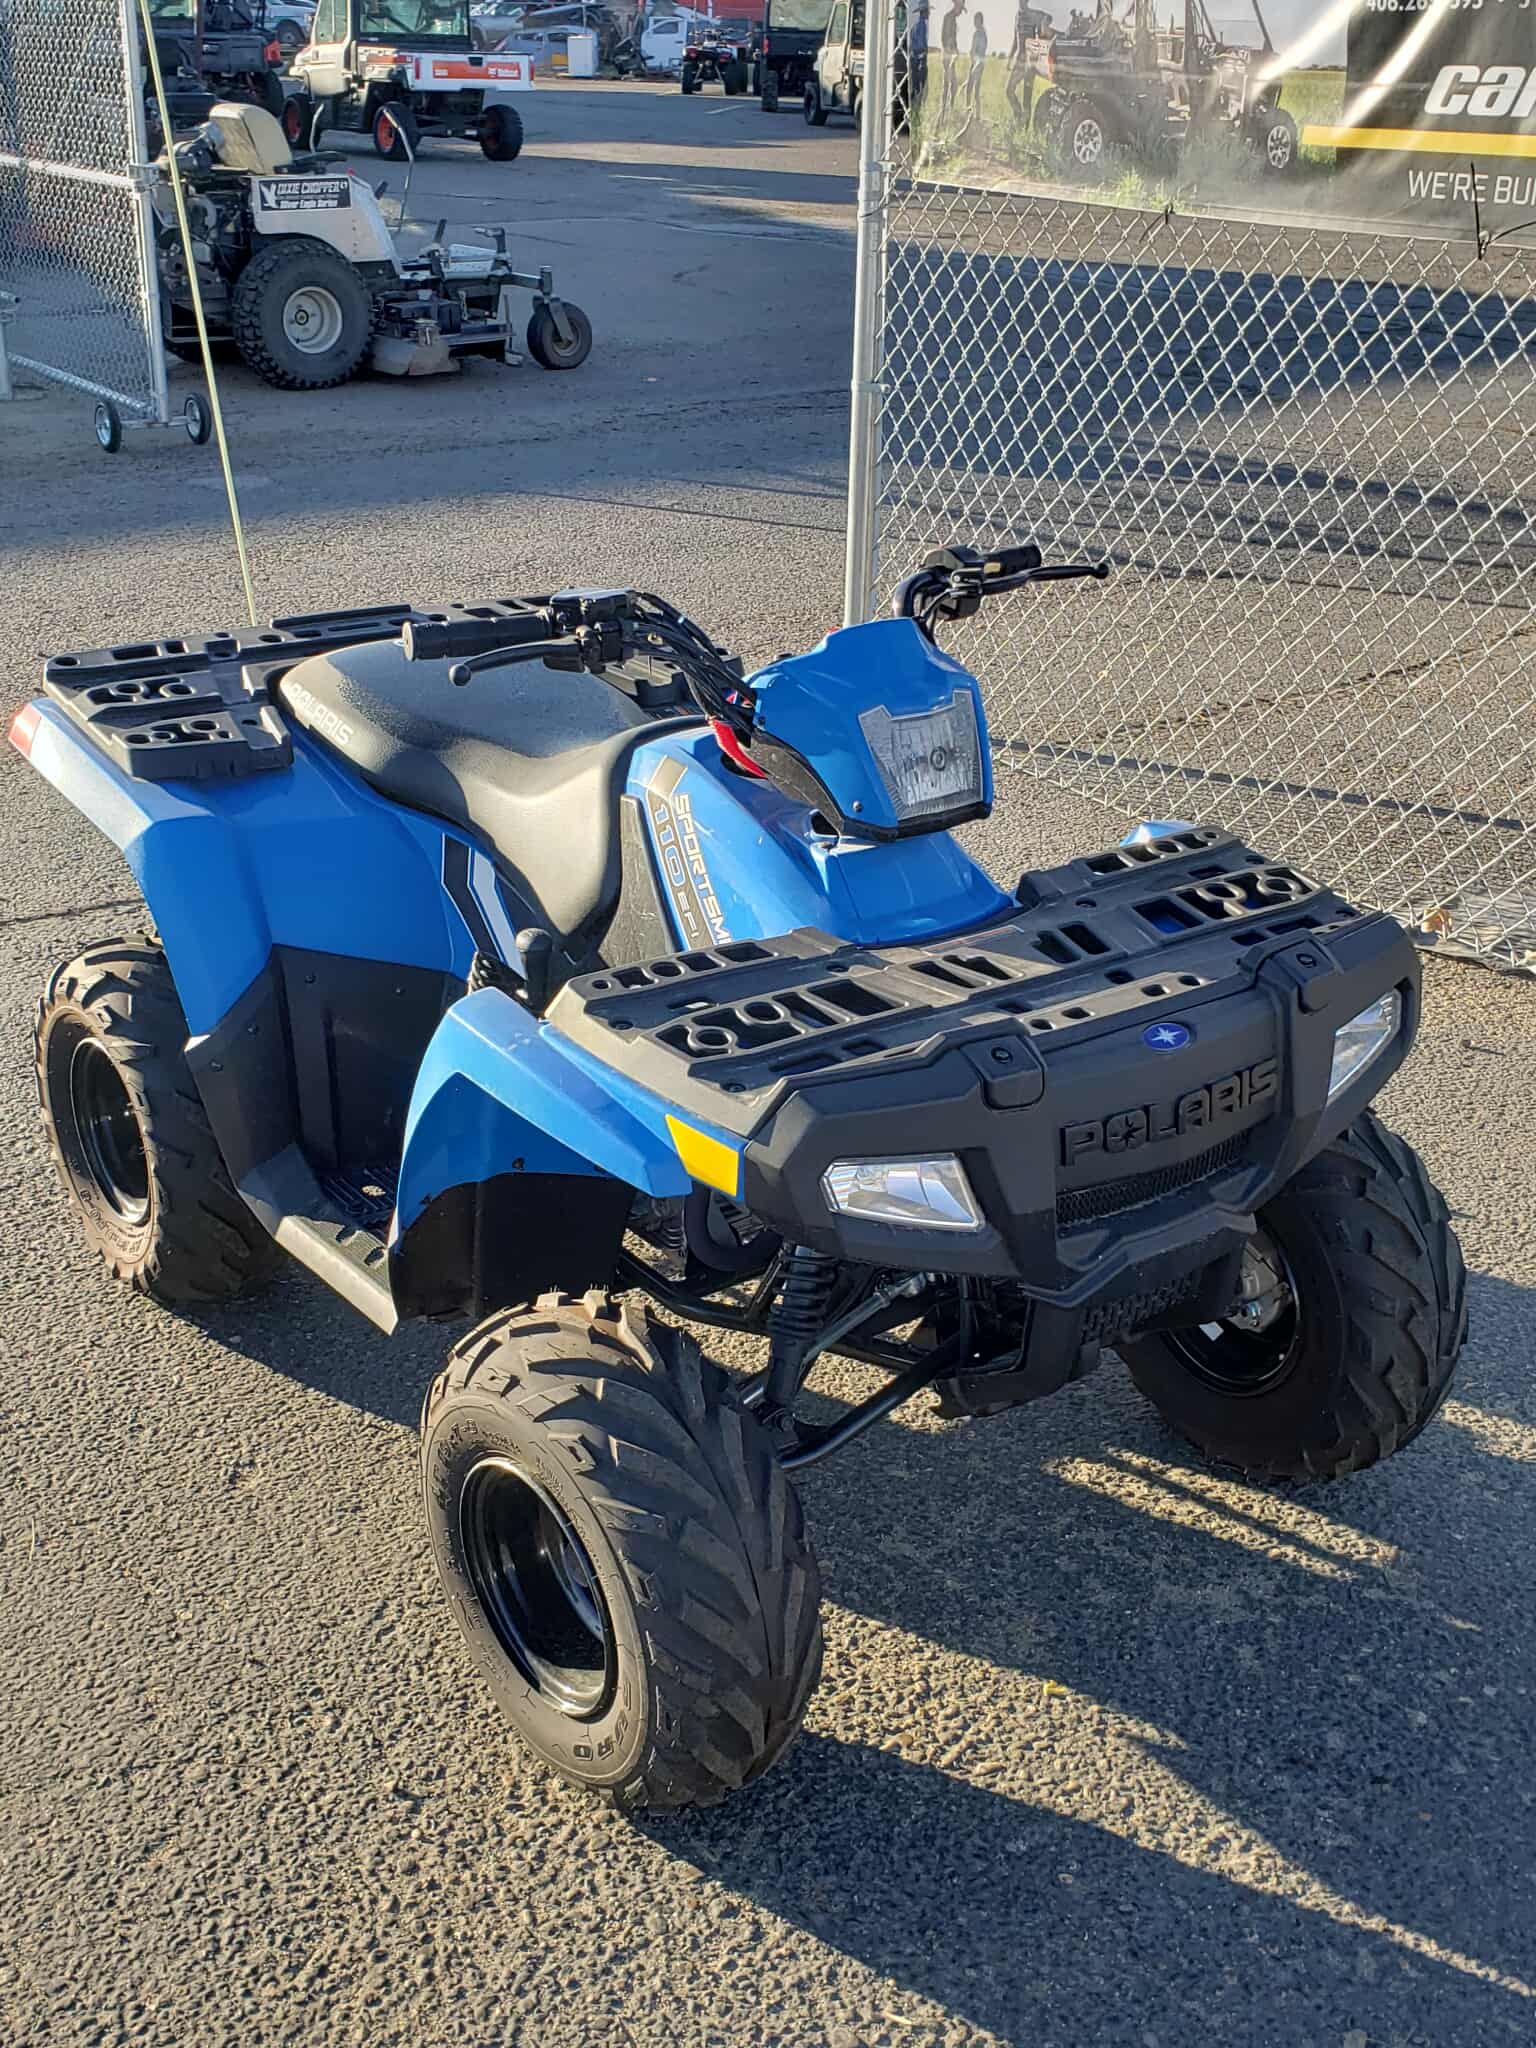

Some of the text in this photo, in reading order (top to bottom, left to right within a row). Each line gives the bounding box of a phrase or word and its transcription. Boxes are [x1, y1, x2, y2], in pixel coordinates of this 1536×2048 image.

[277, 182, 340, 195] DIXIE CHOPPER
[1408, 170, 1488, 203] WE'RE
[290, 683, 354, 744] POLARIS
[655, 803, 700, 938] 110 EFI
[674, 794, 732, 945] SPORTSM
[1060, 1056, 1279, 1168] POLARIS
